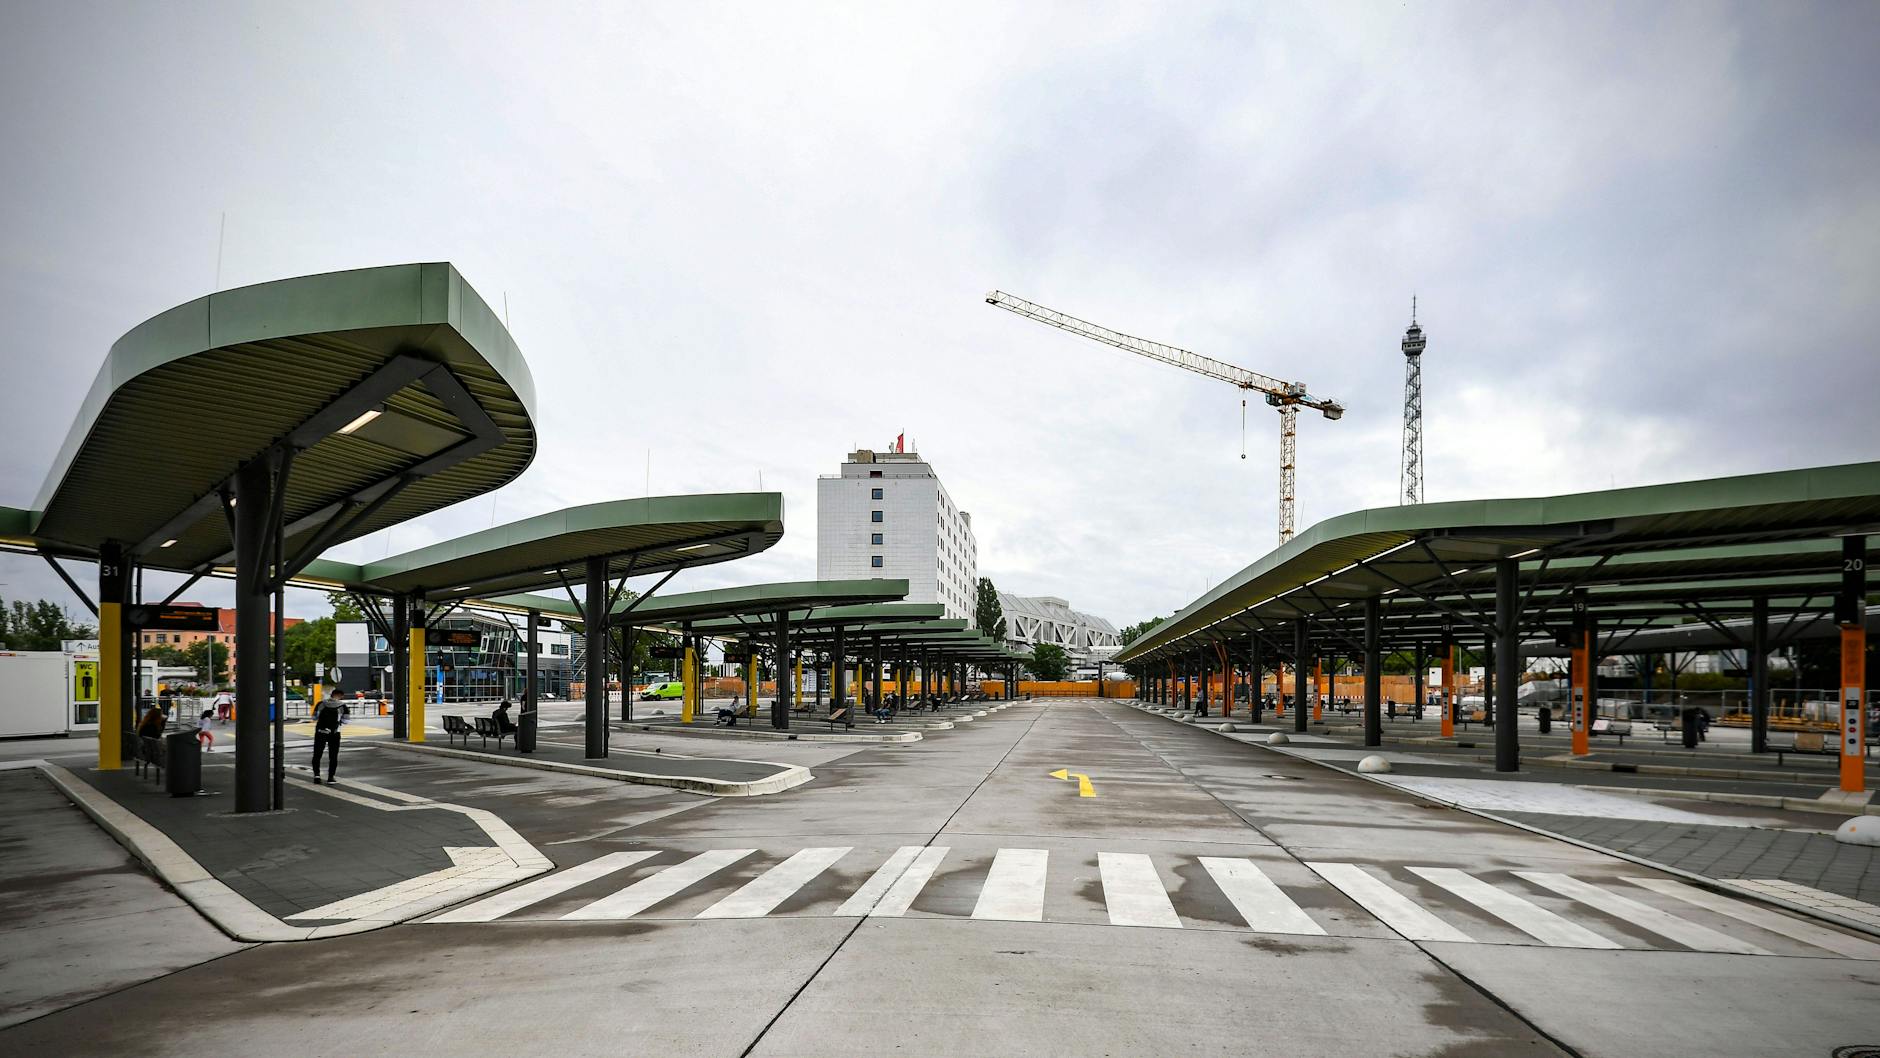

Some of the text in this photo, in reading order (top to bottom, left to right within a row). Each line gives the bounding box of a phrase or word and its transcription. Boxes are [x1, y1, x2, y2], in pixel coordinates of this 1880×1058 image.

[1844, 558, 1863, 571] 20
[103, 565, 118, 577] 31
[1573, 602, 1584, 612] 19
